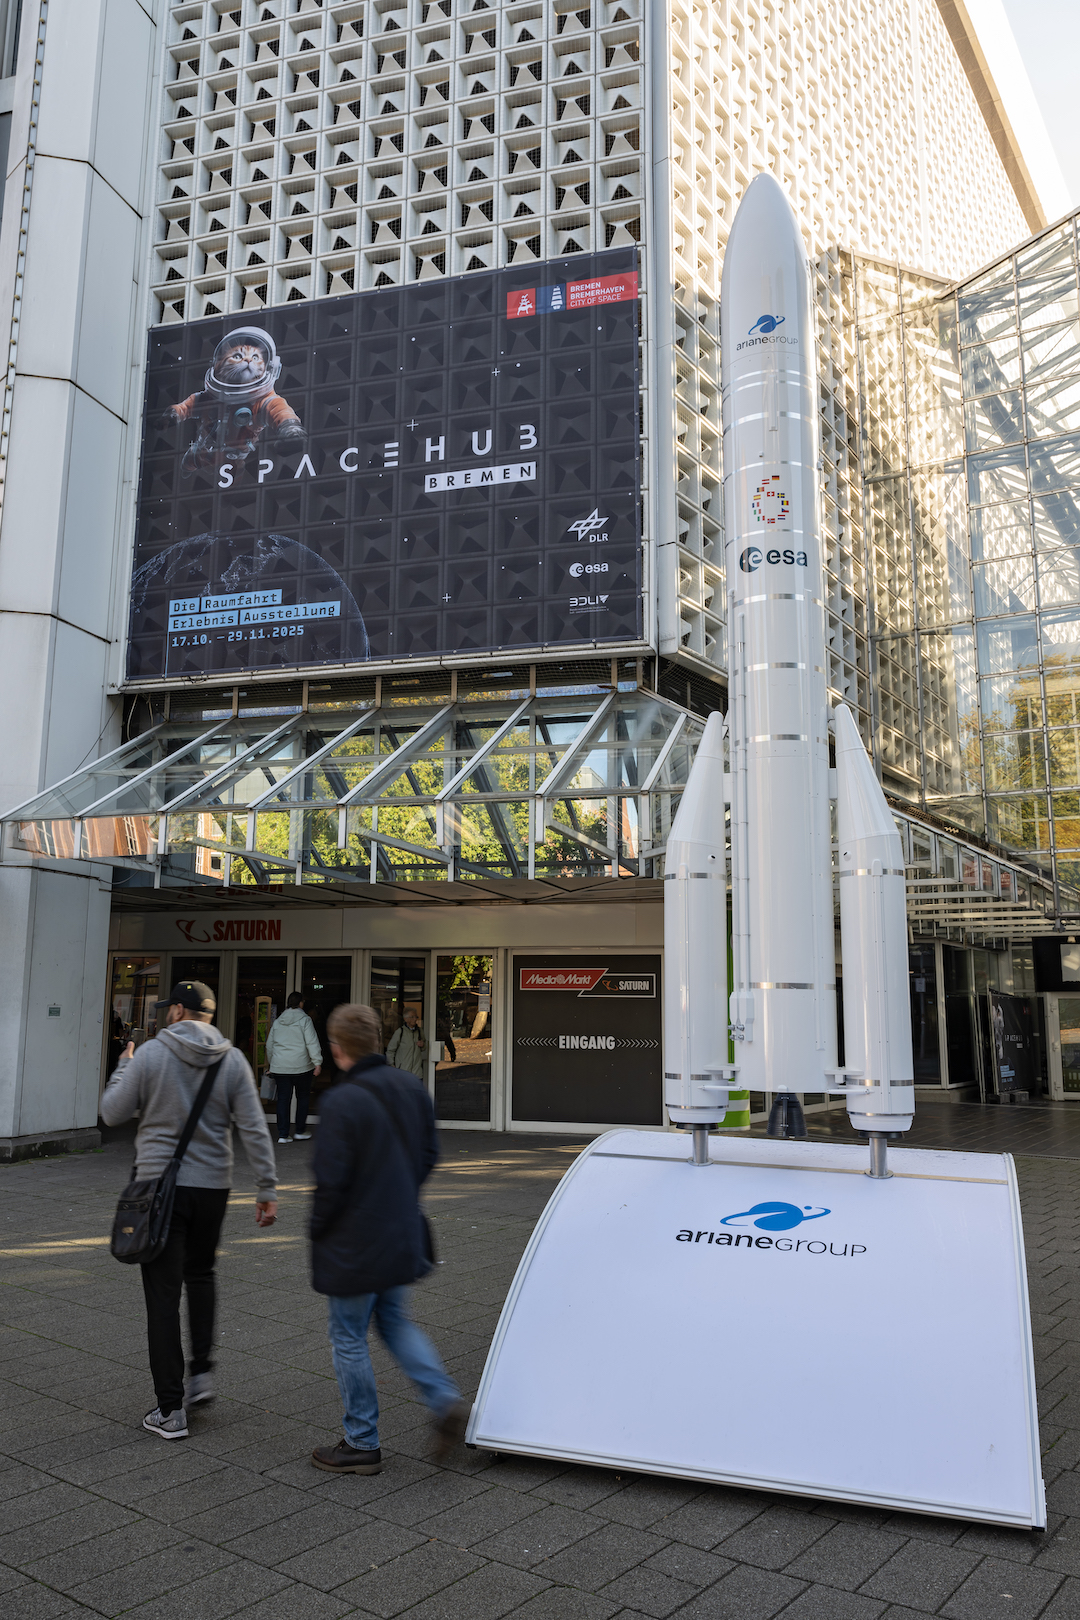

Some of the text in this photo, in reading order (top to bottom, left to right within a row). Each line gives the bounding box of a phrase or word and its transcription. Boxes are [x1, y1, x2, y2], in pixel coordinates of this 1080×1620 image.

[571, 282, 601, 292] BREMEN
[571, 286, 624, 299] BREMERHAVEN
[598, 293, 621, 302] SPACE
[429, 465, 532, 489] BREMEN
[589, 533, 608, 542] DLR
[766, 549, 808, 567] esa
[585, 563, 608, 573] esa
[173, 592, 278, 612] Die Raumfahrt
[173, 605, 335, 629] Erlebnis Ausstellung
[227, 625, 305, 642] 29.11.2025
[212, 919, 282, 941] SATURN
[618, 981, 650, 991] SATURN
[558, 1035, 616, 1050] EINGANG
